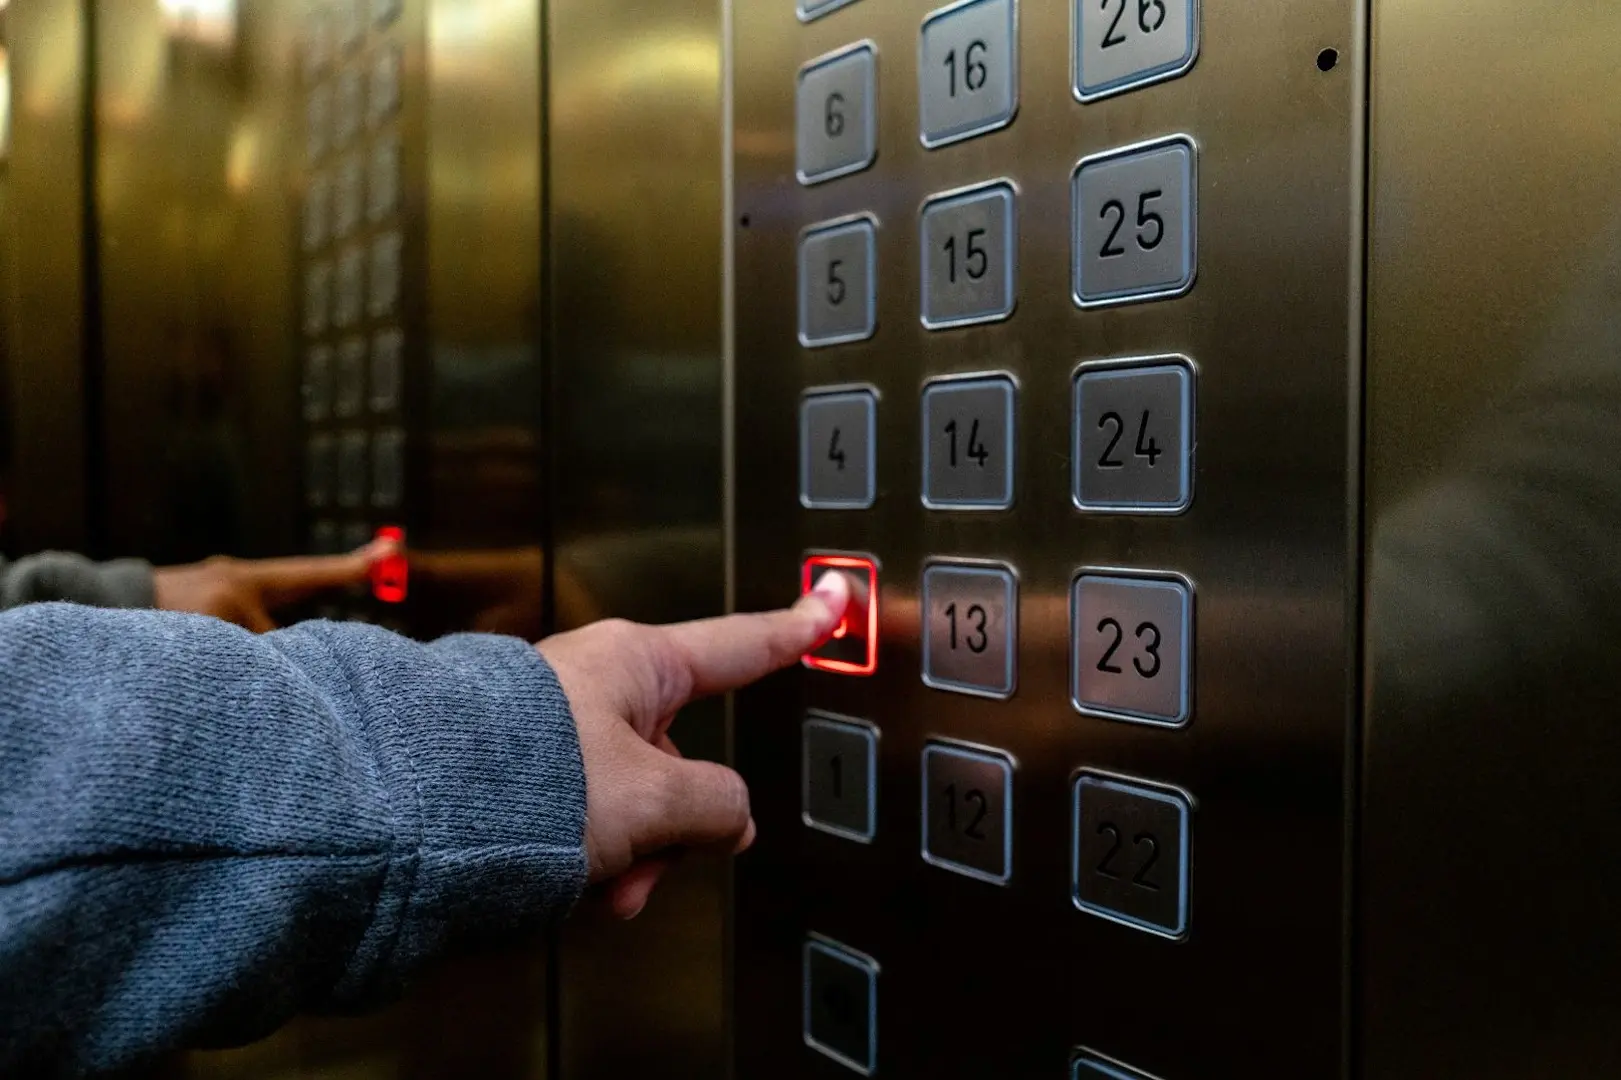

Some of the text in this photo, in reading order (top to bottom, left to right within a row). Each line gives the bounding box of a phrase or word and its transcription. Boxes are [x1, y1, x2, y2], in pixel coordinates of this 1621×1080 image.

[944, 41, 987, 97] 16
[825, 94, 844, 137] 6
[1099, 190, 1164, 257] 25
[827, 261, 846, 305] 5
[944, 229, 988, 283] 15
[828, 428, 845, 470] 4
[944, 419, 989, 467] 14
[1097, 410, 1161, 467] 24
[945, 603, 988, 653] 13
[1097, 618, 1161, 678] 23
[830, 755, 842, 798] 1
[943, 783, 987, 840] 12
[1096, 823, 1161, 891] 22
